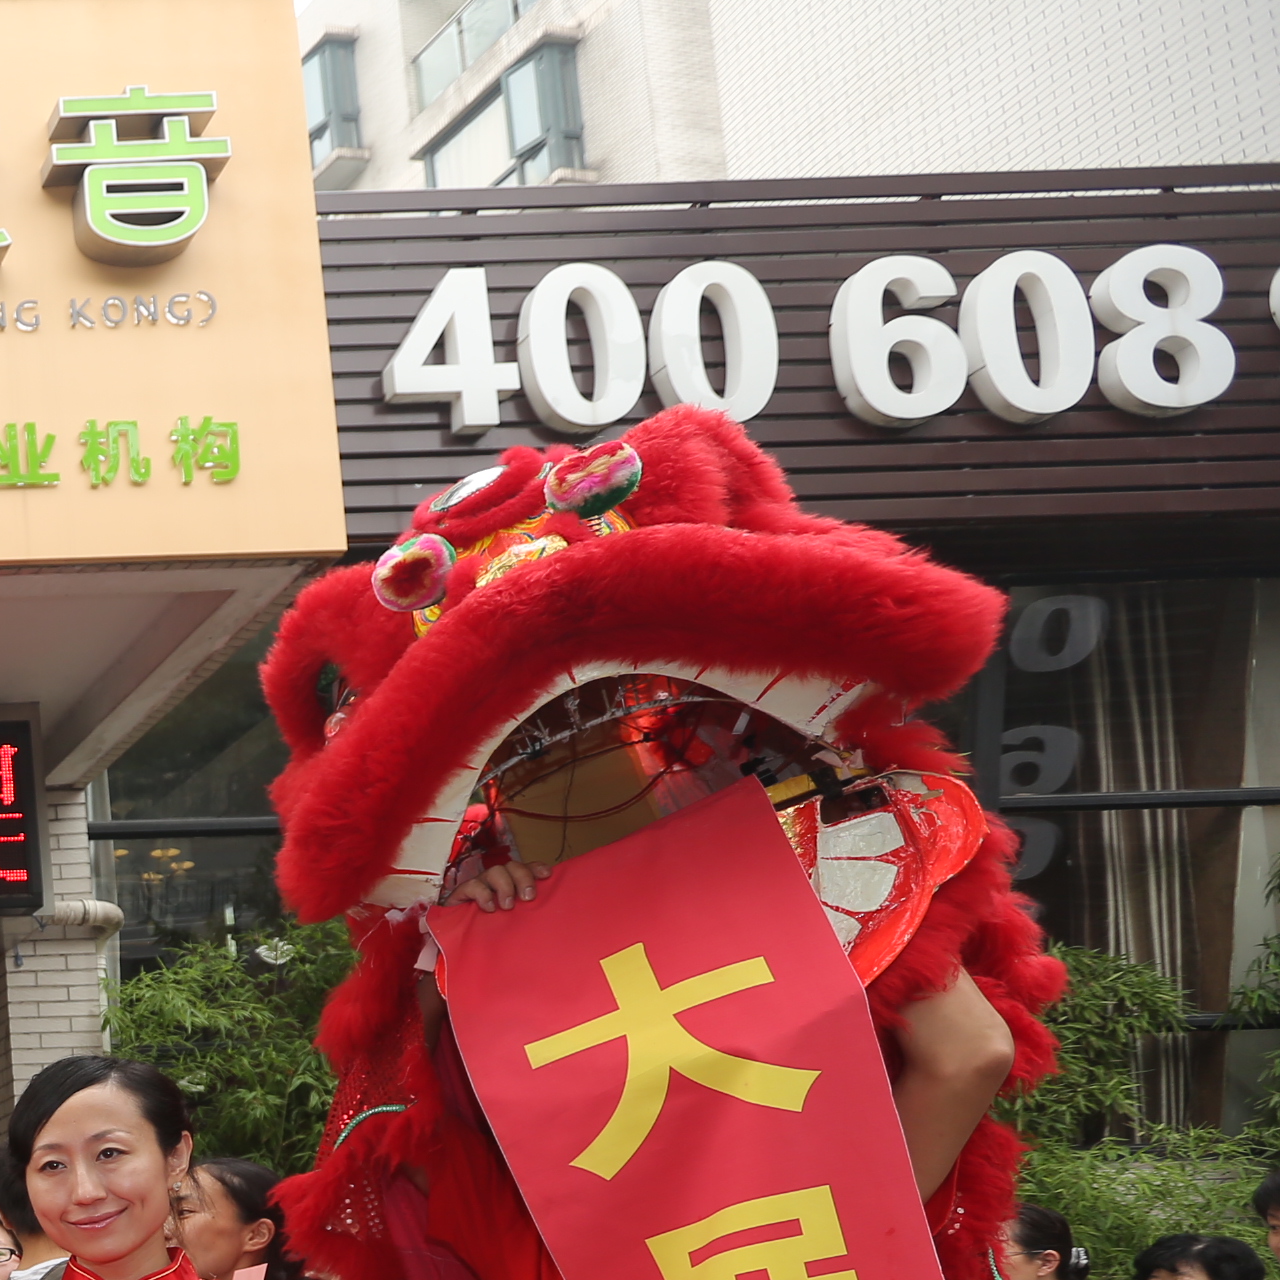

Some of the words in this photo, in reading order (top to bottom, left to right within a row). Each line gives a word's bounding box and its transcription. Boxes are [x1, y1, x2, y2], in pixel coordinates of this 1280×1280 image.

[68, 290, 219, 329] KONG)
[383, 260, 779, 434] 400
[829, 243, 1236, 428] 608
